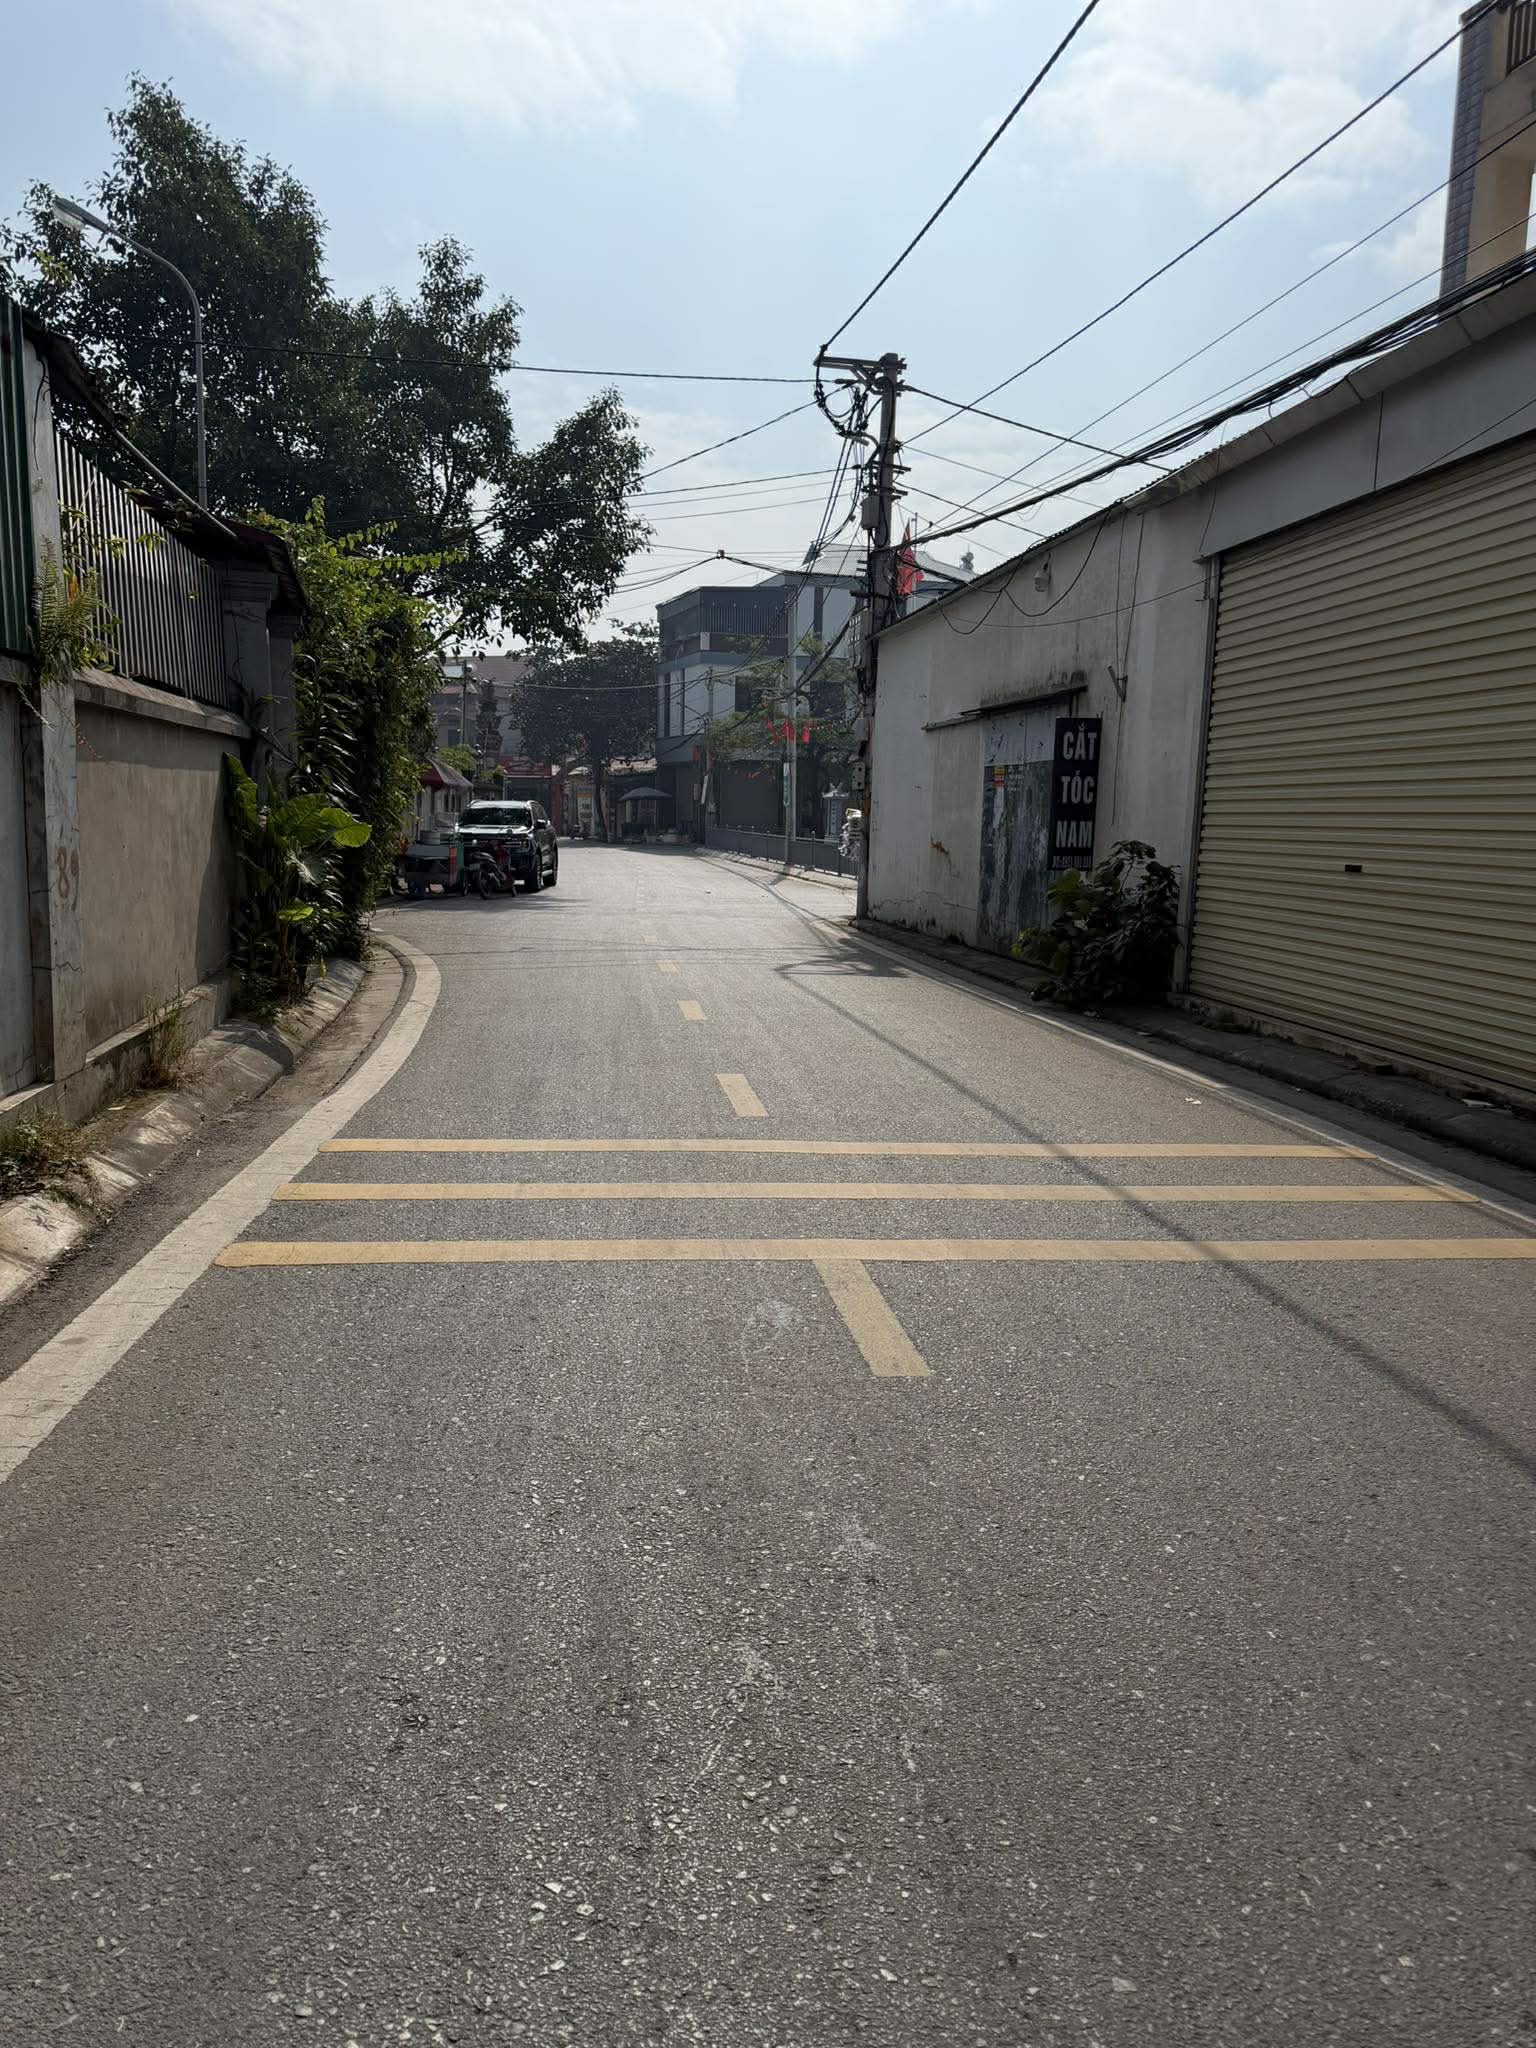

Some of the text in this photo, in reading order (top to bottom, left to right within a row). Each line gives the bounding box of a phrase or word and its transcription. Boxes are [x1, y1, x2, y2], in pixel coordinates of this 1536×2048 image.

[1063, 722, 1097, 760] CẮT
[1061, 770, 1095, 804] TÓC
[1055, 820, 1093, 848] NAM
